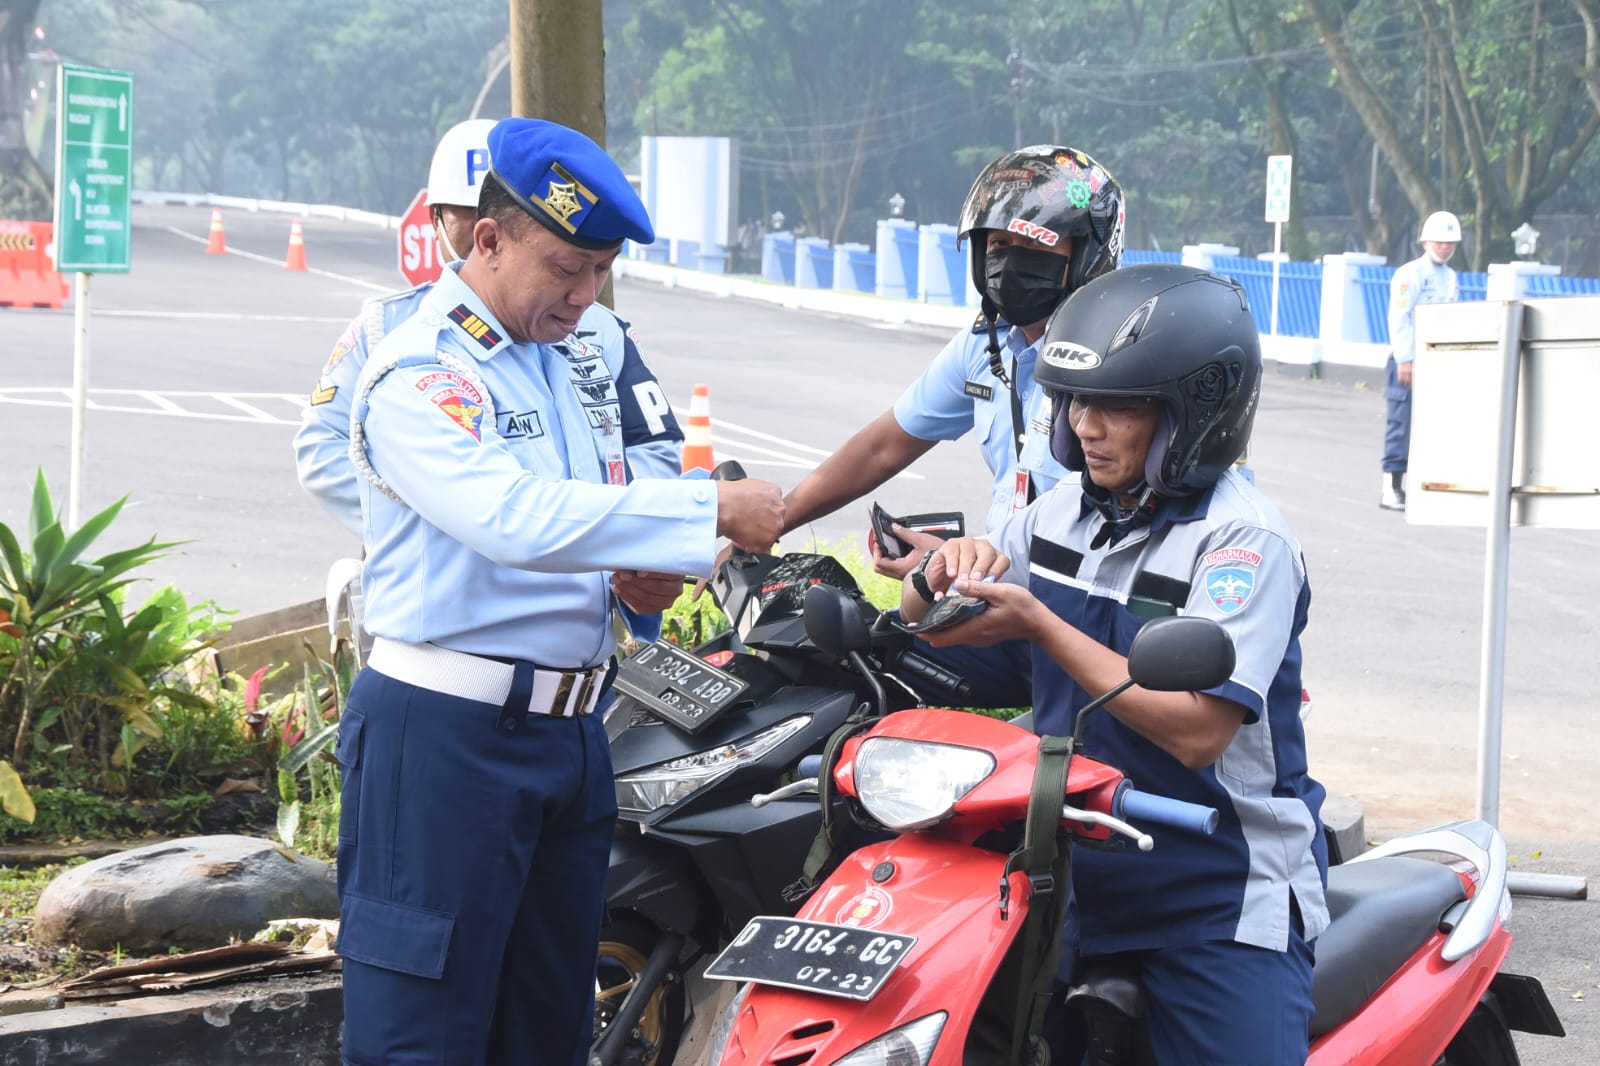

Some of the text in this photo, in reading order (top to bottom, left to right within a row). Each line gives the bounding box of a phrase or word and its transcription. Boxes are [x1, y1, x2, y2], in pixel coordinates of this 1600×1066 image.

[403, 224, 444, 271] ST
[1009, 220, 1058, 245] KYB
[1046, 346, 1093, 363] INK
[632, 380, 669, 436] P
[636, 647, 659, 665] D
[652, 656, 701, 685] 3394
[733, 922, 903, 965] D 3164 GC
